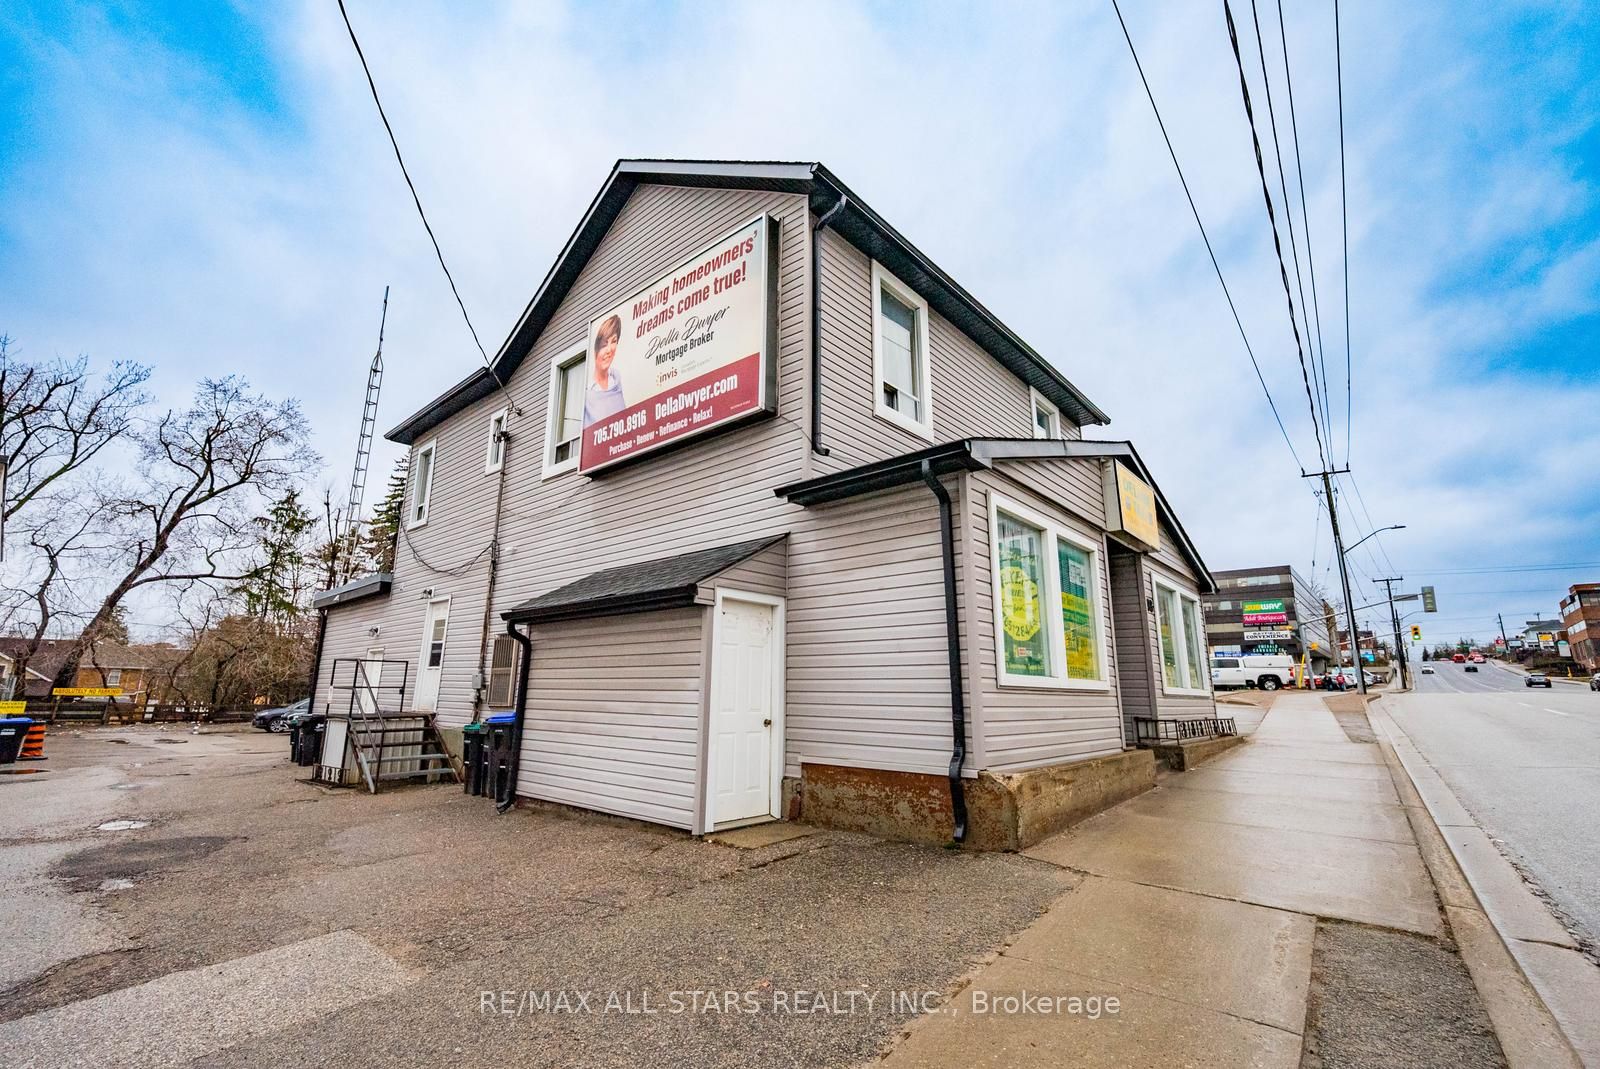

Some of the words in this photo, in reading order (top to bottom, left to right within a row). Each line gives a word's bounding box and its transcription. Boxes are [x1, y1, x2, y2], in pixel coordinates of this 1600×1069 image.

[632, 285, 669, 320] Making
[672, 230, 758, 295] homeowners'
[636, 305, 675, 338] dreams
[677, 285, 710, 315] come
[713, 261, 746, 295] true!
[645, 328, 679, 359] Della
[681, 306, 730, 340] Dwyer
[656, 344, 688, 367] Mortgage
[689, 331, 714, 351] Broker
[593, 410, 647, 446] 705.790.8916
[655, 374, 738, 420] DellaDwyer.com
[609, 440, 633, 456] Purchase
[636, 431, 655, 446] Renew
[659, 418, 688, 437] Refinance
[693, 406, 713, 424] Relax!
[1244, 603, 1282, 611] SUBWAY
